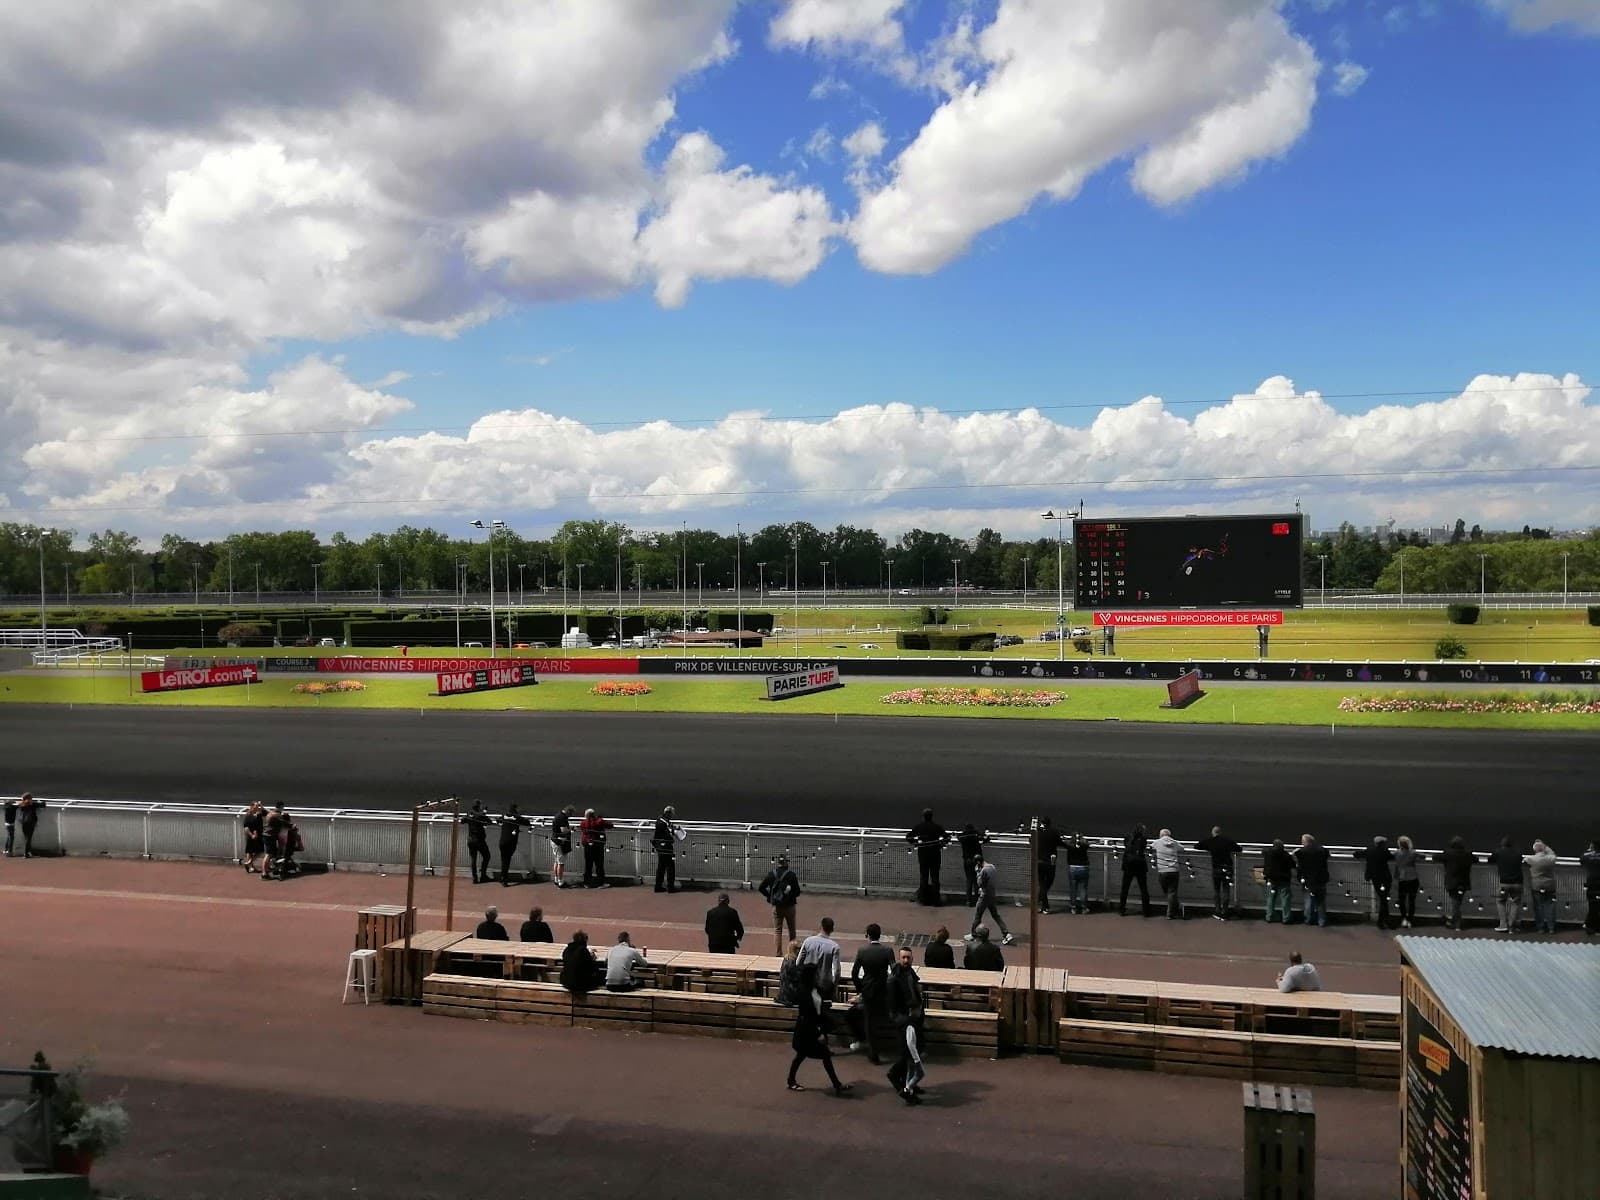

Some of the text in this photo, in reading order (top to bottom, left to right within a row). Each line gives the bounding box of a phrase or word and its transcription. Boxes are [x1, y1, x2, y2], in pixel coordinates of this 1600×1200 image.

[1144, 591, 1151, 599] 3
[1115, 614, 1278, 623] VINCENNES HIPPODROME DE PARIS
[340, 660, 414, 671] VINCENNES
[418, 660, 507, 671] HIPPODROME
[535, 660, 570, 671] PARIS
[675, 662, 698, 671] PRIX
[701, 662, 714, 671] DE
[971, 665, 977, 673] 1
[1021, 665, 1028, 674] 2
[1072, 666, 1079, 675] 3
[1125, 667, 1132, 675] 4
[1179, 667, 1186, 676] 5
[1233, 668, 1240, 676] 6
[1289, 668, 1296, 677] 7
[1346, 668, 1353, 678] 8
[1404, 669, 1411, 678] 9
[1460, 669, 1473, 679] 10
[1520, 670, 1531, 679] 11
[1580, 670, 1593, 680] 12
[159, 669, 243, 687] LeTROT.com
[491, 667, 520, 685] RMC
[442, 673, 473, 691] RMC
